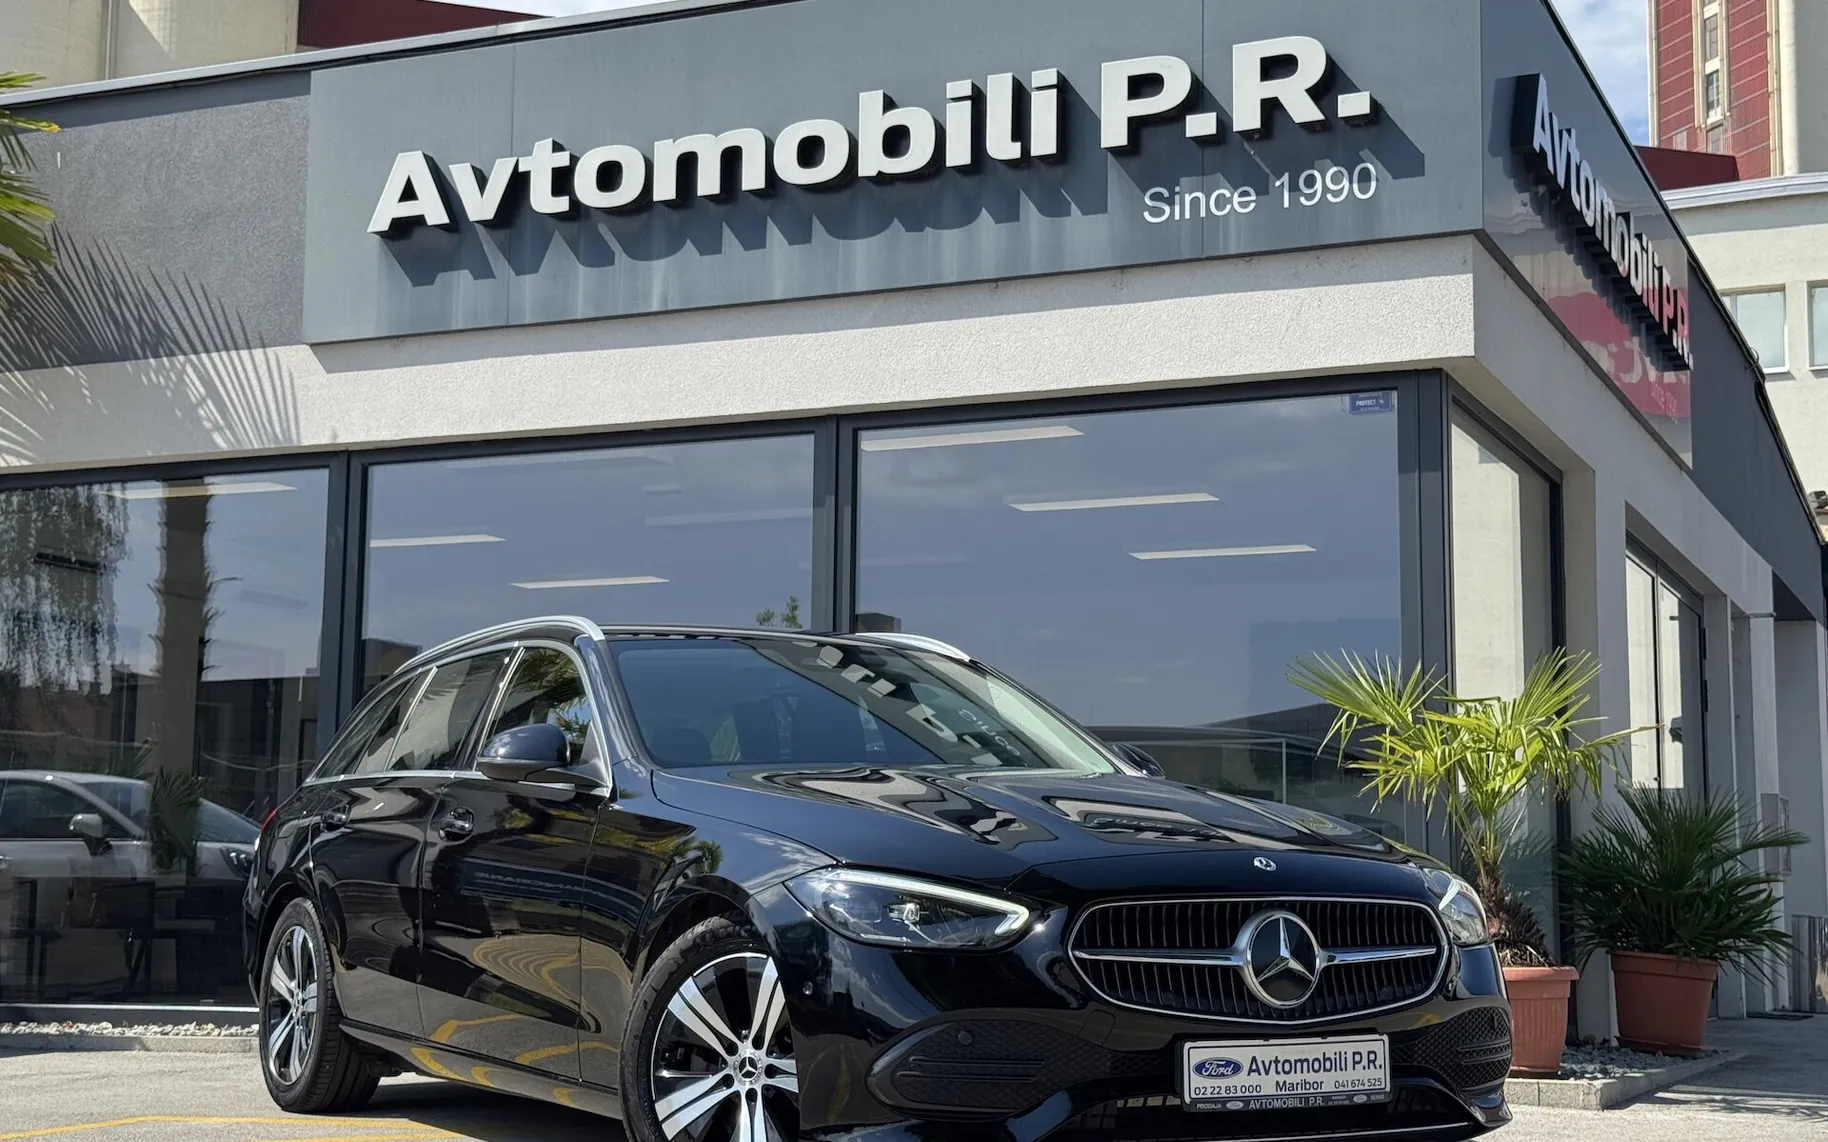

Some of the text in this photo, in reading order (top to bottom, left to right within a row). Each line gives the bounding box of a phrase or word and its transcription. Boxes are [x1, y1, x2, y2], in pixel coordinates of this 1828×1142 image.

[367, 35, 1371, 235] Avtomobili P.R.
[1142, 161, 1378, 223] Since 1990
[1531, 72, 1660, 323] Avtomobili
[1201, 1050, 1383, 1077] Ford Avtomobili P.R.
[1194, 1078, 1383, 1096] 02 22 83 000 Maribor 041 674 525
[1248, 1096, 1305, 1109] AVTOMOBILI
[1309, 1096, 1325, 1107] P.R.
